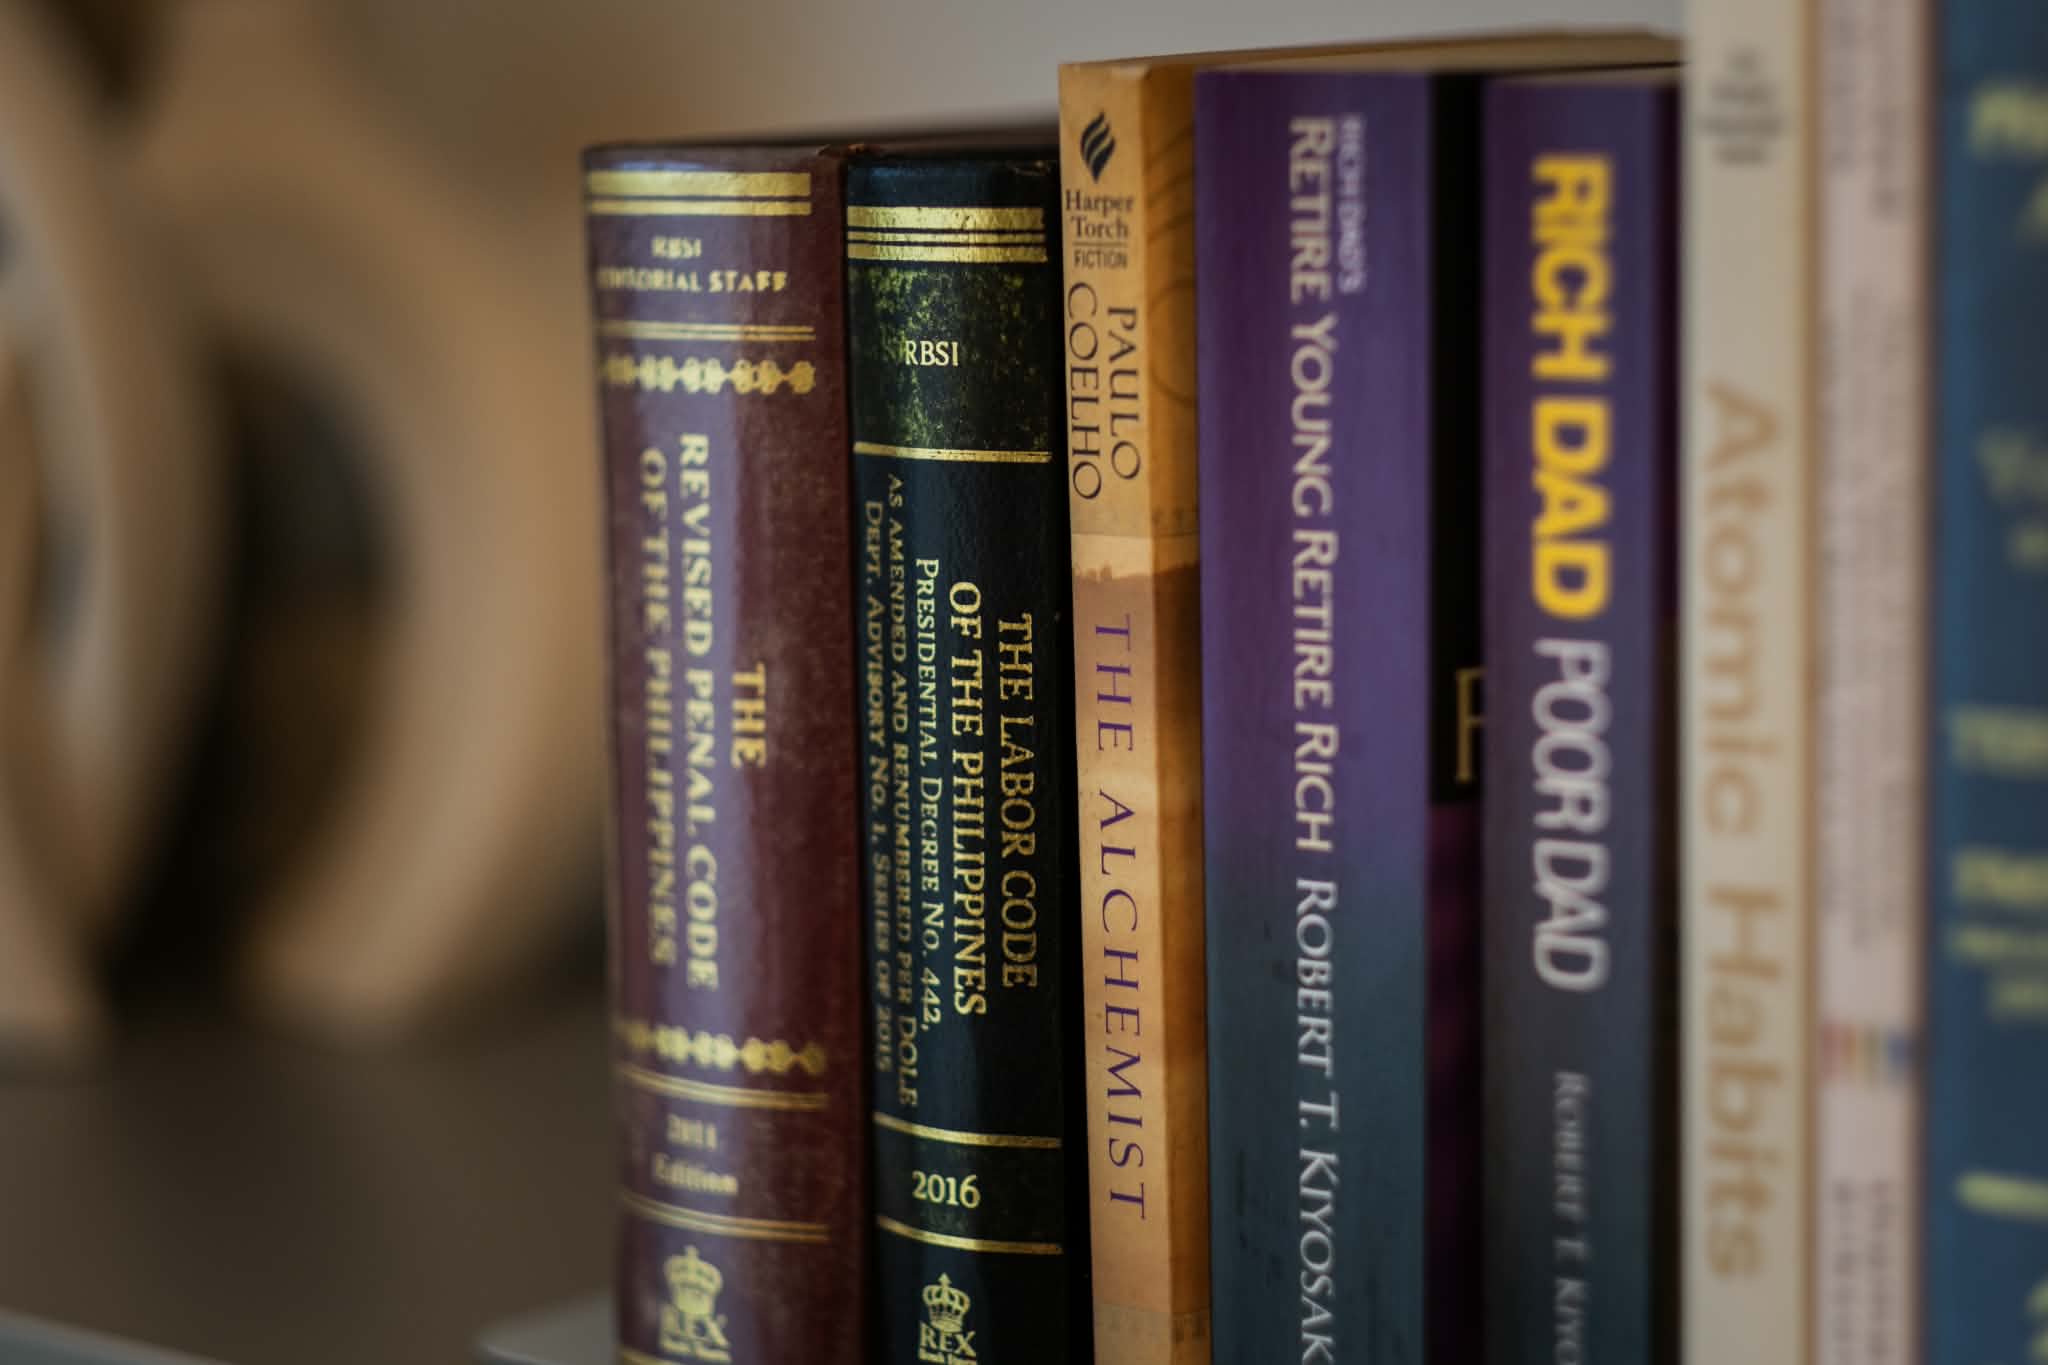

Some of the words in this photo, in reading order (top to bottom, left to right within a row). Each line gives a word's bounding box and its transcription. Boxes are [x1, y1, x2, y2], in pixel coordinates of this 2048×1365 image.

[1065, 189, 1134, 216] Harper
[1071, 216, 1128, 239] Torch
[1073, 250, 1127, 268] FICTION
[1290, 116, 1334, 303] RETIRE
[1531, 155, 1612, 381] RICH
[709, 270, 788, 293] STAFF
[904, 340, 959, 367] RBSI
[1067, 282, 1102, 500] COELHO
[1107, 306, 1141, 480] PAULO
[1291, 312, 1337, 518] YOUNG
[640, 447, 669, 522] OF
[680, 433, 712, 656] REVISED
[888, 473, 904, 508] AS
[1531, 397, 1612, 620] DAD
[641, 527, 672, 633] THE
[888, 517, 907, 662] AMENDED
[949, 581, 982, 640] OF
[1292, 529, 1337, 710] RETIRE
[1704, 378, 1782, 838] Atomic
[731, 661, 766, 768] THE
[866, 597, 886, 748] ADVISORY
[891, 671, 909, 734] AND
[915, 558, 939, 767] PRESIDENTIAL
[951, 649, 984, 737] THE
[998, 612, 1034, 701] THE
[1095, 613, 1133, 751] THE
[685, 668, 715, 836] PENAL
[1000, 714, 1036, 859] LABOR
[1294, 723, 1338, 853] RICH
[1531, 638, 1612, 833] POOR
[646, 648, 677, 967] PHILIPPINES
[891, 742, 913, 943] RENUMBERED
[920, 775, 942, 892] DECREE
[686, 845, 718, 990] CODE
[952, 749, 988, 1016] PHILIPPINES
[1001, 870, 1038, 988] CODE
[1532, 838, 1612, 991] DAD
[896, 951, 913, 1004] PER
[920, 967, 942, 1032] 442,
[1099, 789, 1145, 1220] ALCHEMIST
[1296, 878, 1339, 1079] ROBERT
[897, 1016, 918, 1106] DOLE
[1299, 1090, 1340, 1130] T.
[1704, 886, 1785, 1283] Habits
[911, 1170, 980, 1208] 2016
[917, 1320, 977, 1357] REX
